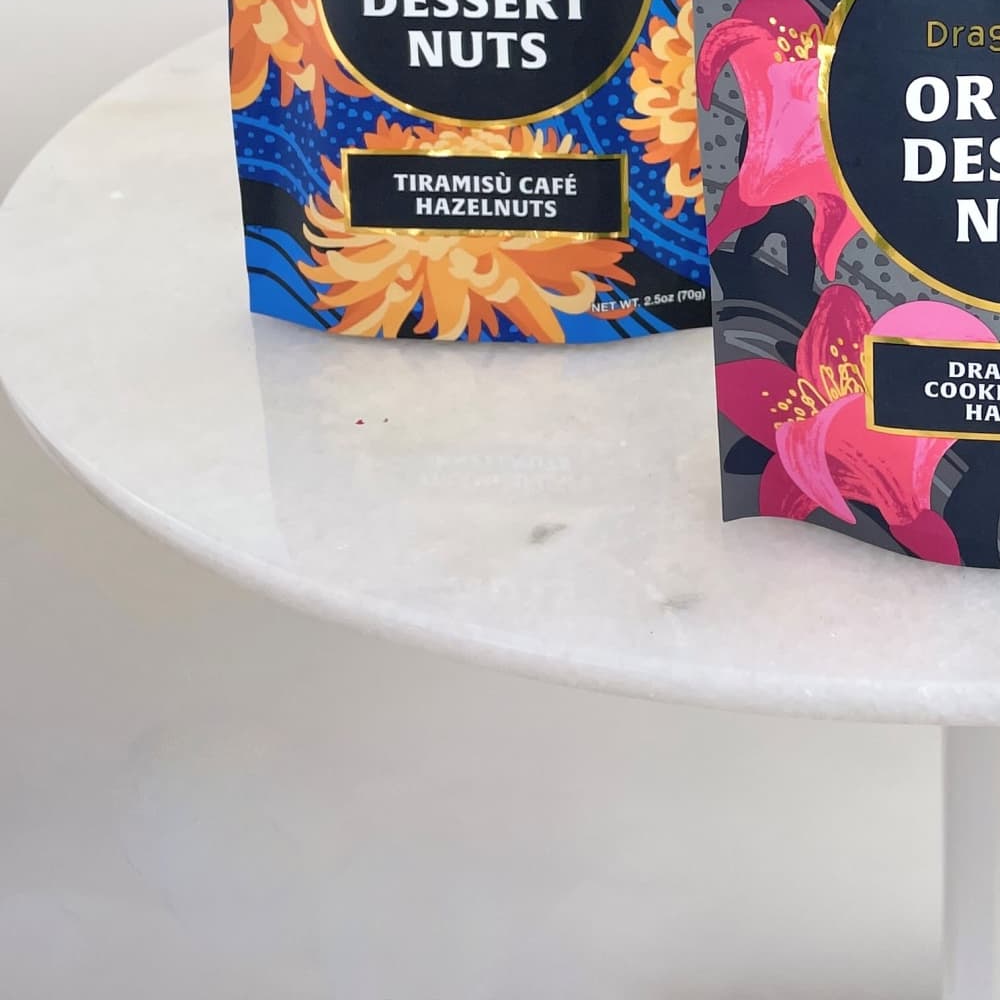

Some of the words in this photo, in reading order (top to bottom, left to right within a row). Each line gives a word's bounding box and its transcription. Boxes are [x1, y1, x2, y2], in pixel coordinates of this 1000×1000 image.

[408, 29, 548, 70] NUTS
[393, 171, 512, 195] TIRAMISÙ
[519, 172, 578, 196] CAFÉ
[415, 197, 558, 219] HAZELNUTS
[591, 301, 618, 314] NET
[677, 288, 706, 304] (70g)
